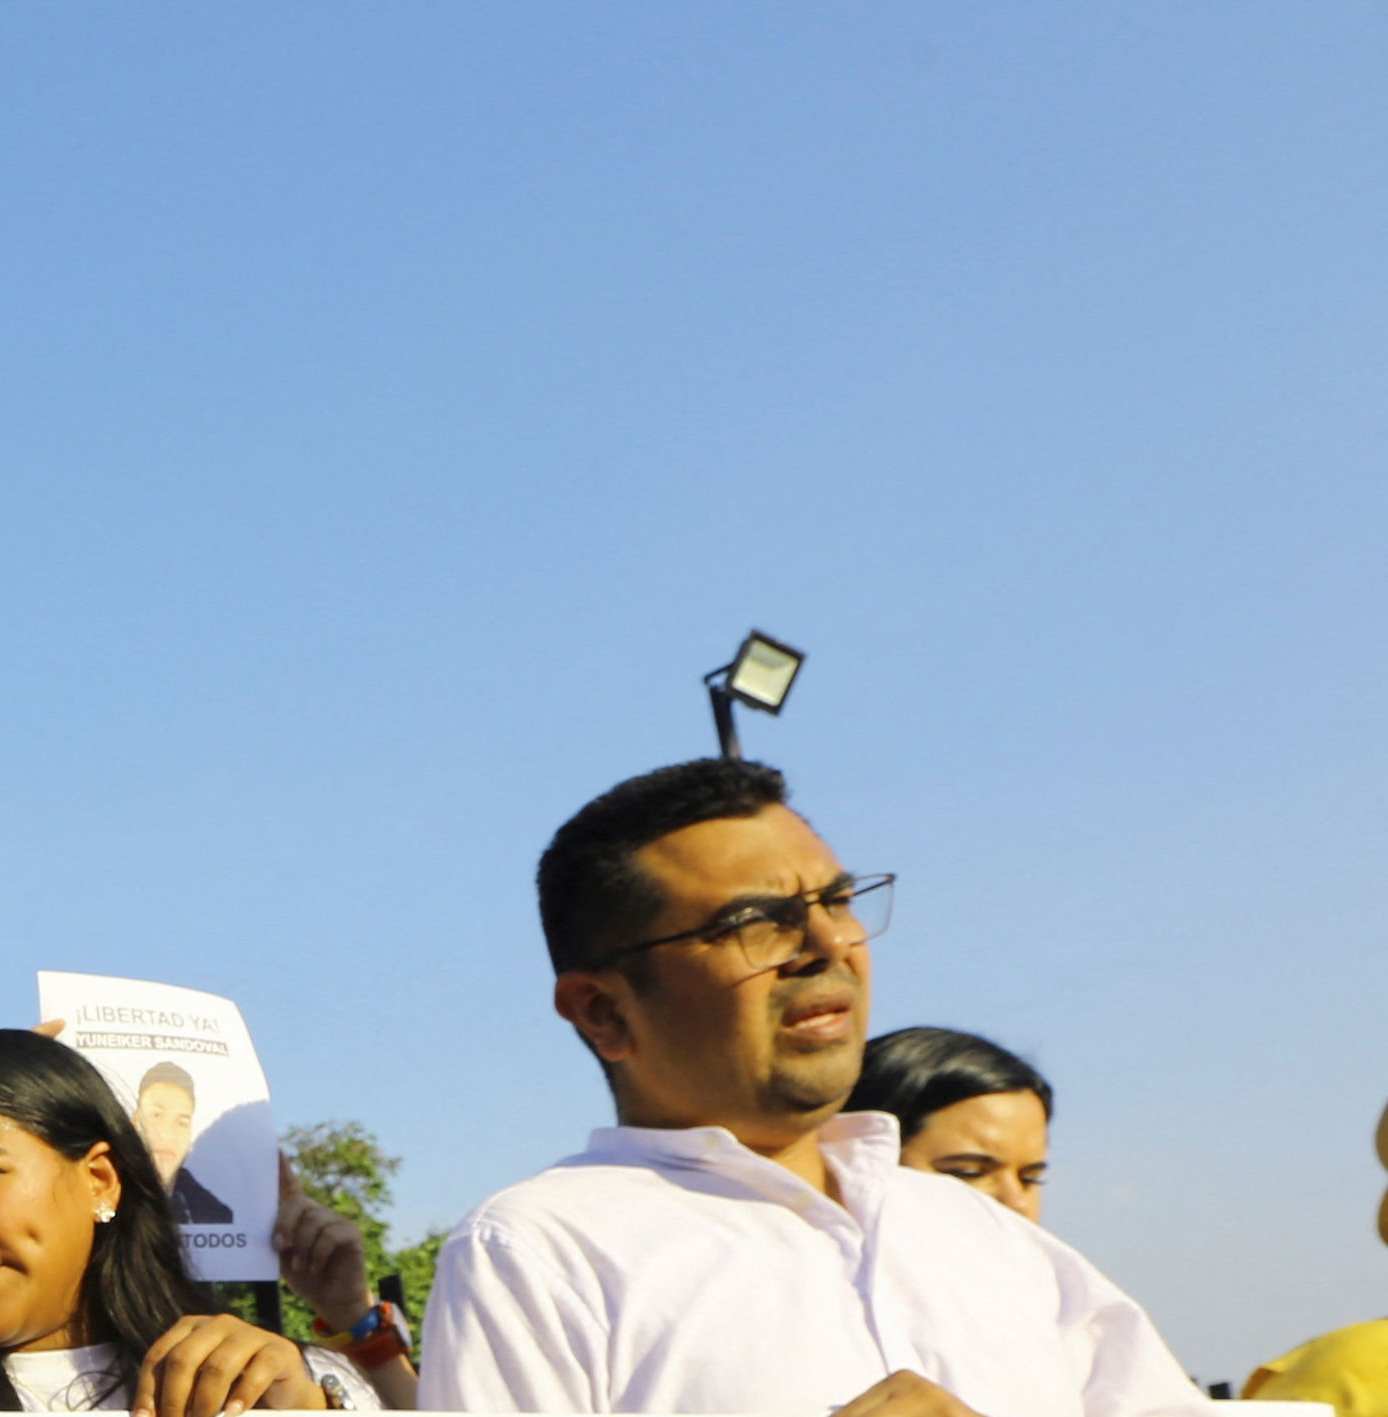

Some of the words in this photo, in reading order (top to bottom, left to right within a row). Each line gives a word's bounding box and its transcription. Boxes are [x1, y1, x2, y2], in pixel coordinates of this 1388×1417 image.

[76, 1005, 184, 1028] ¡LIBERTAD
[76, 1032, 152, 1049] YUNEIKER
[154, 1036, 228, 1055] SANDOVAL
[177, 1233, 247, 1248] TODOS
